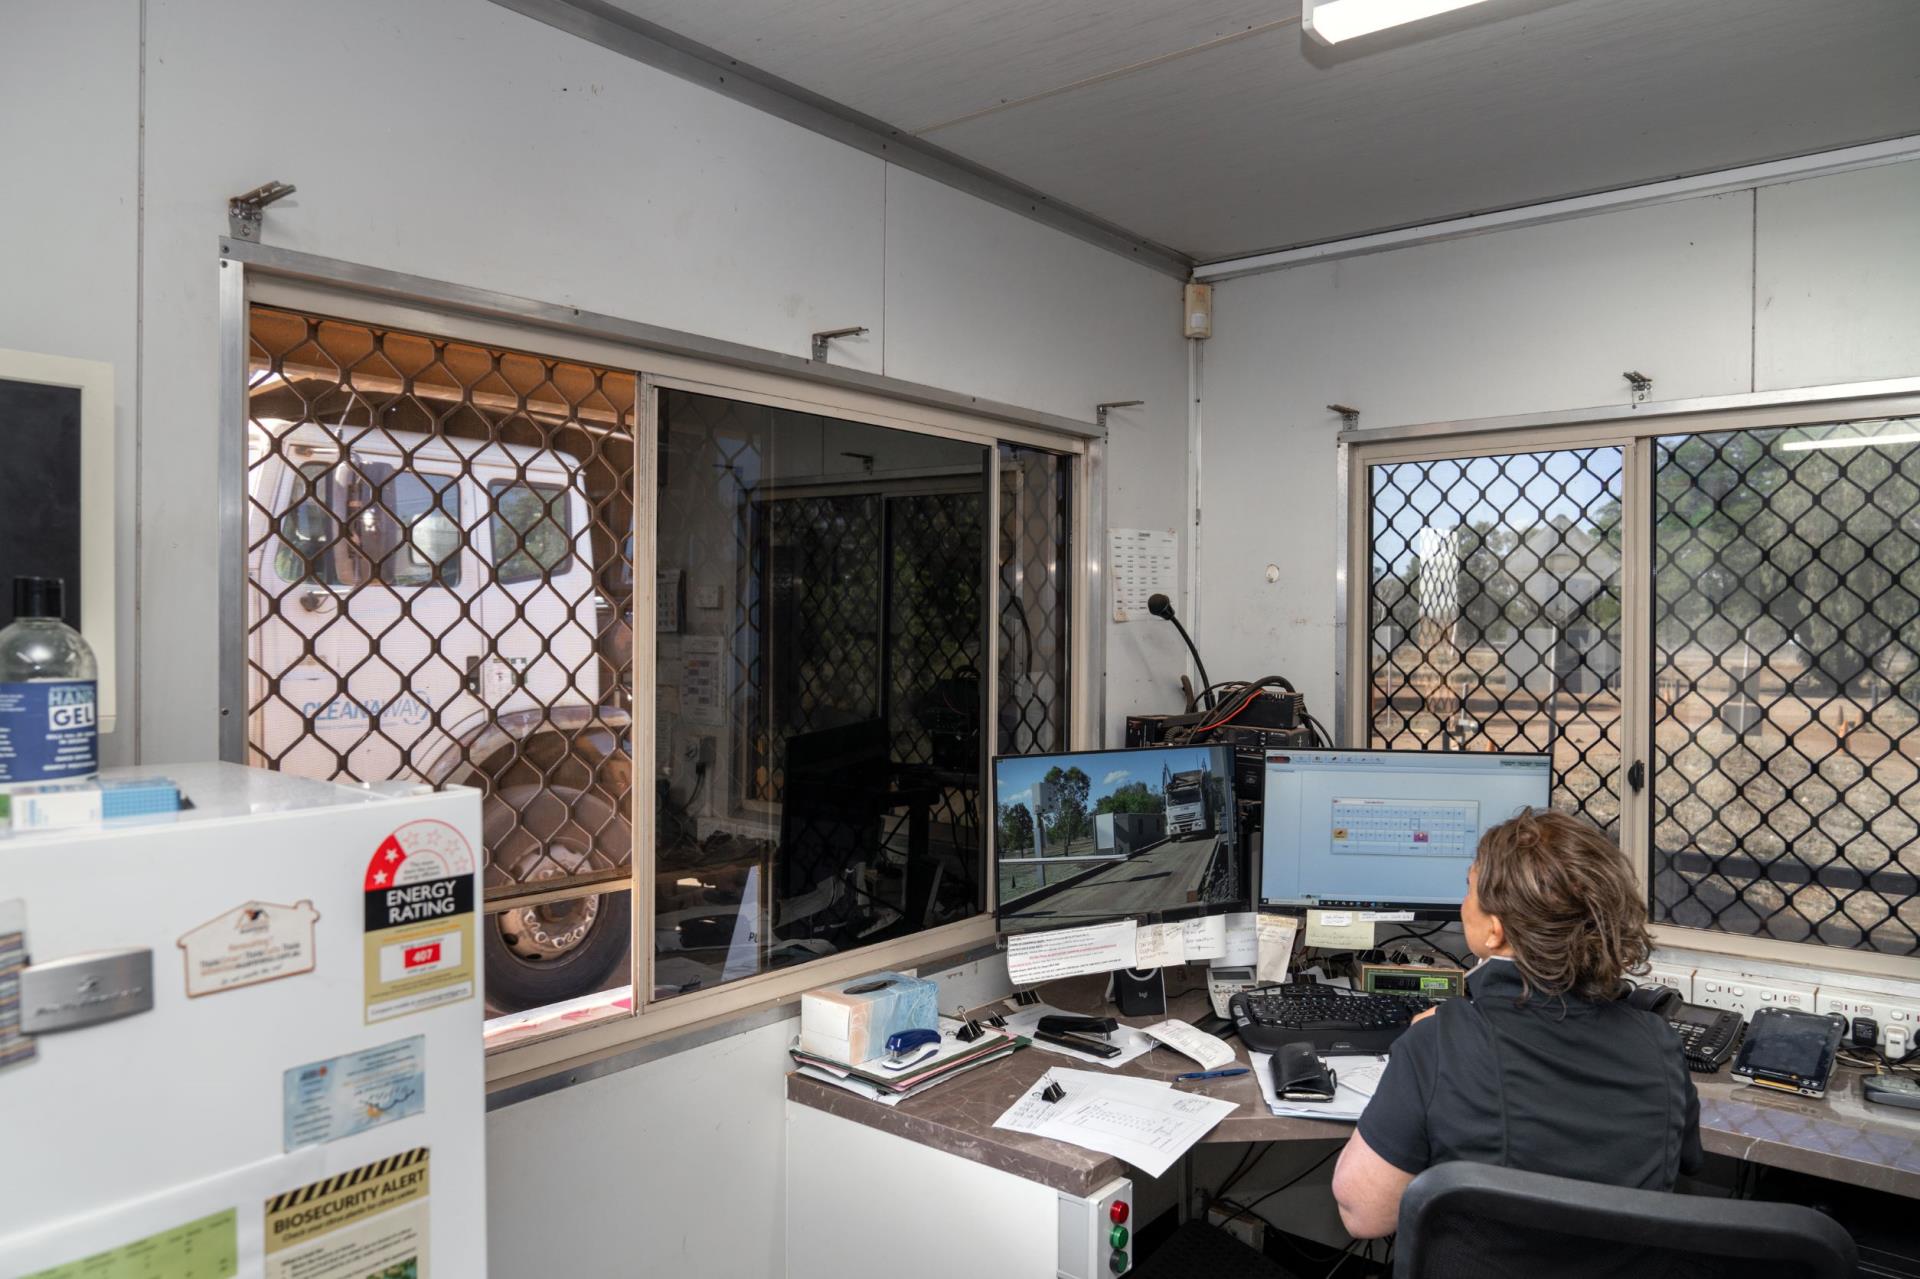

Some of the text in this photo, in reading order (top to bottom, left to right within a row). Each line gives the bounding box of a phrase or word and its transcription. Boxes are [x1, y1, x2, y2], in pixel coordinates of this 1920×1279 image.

[54, 705, 92, 726] GEL
[386, 880, 456, 907] ENERGY
[388, 897, 455, 924] RATING
[412, 948, 433, 963] 407
[273, 1168, 426, 1234] BIOSECURITY ALERT
